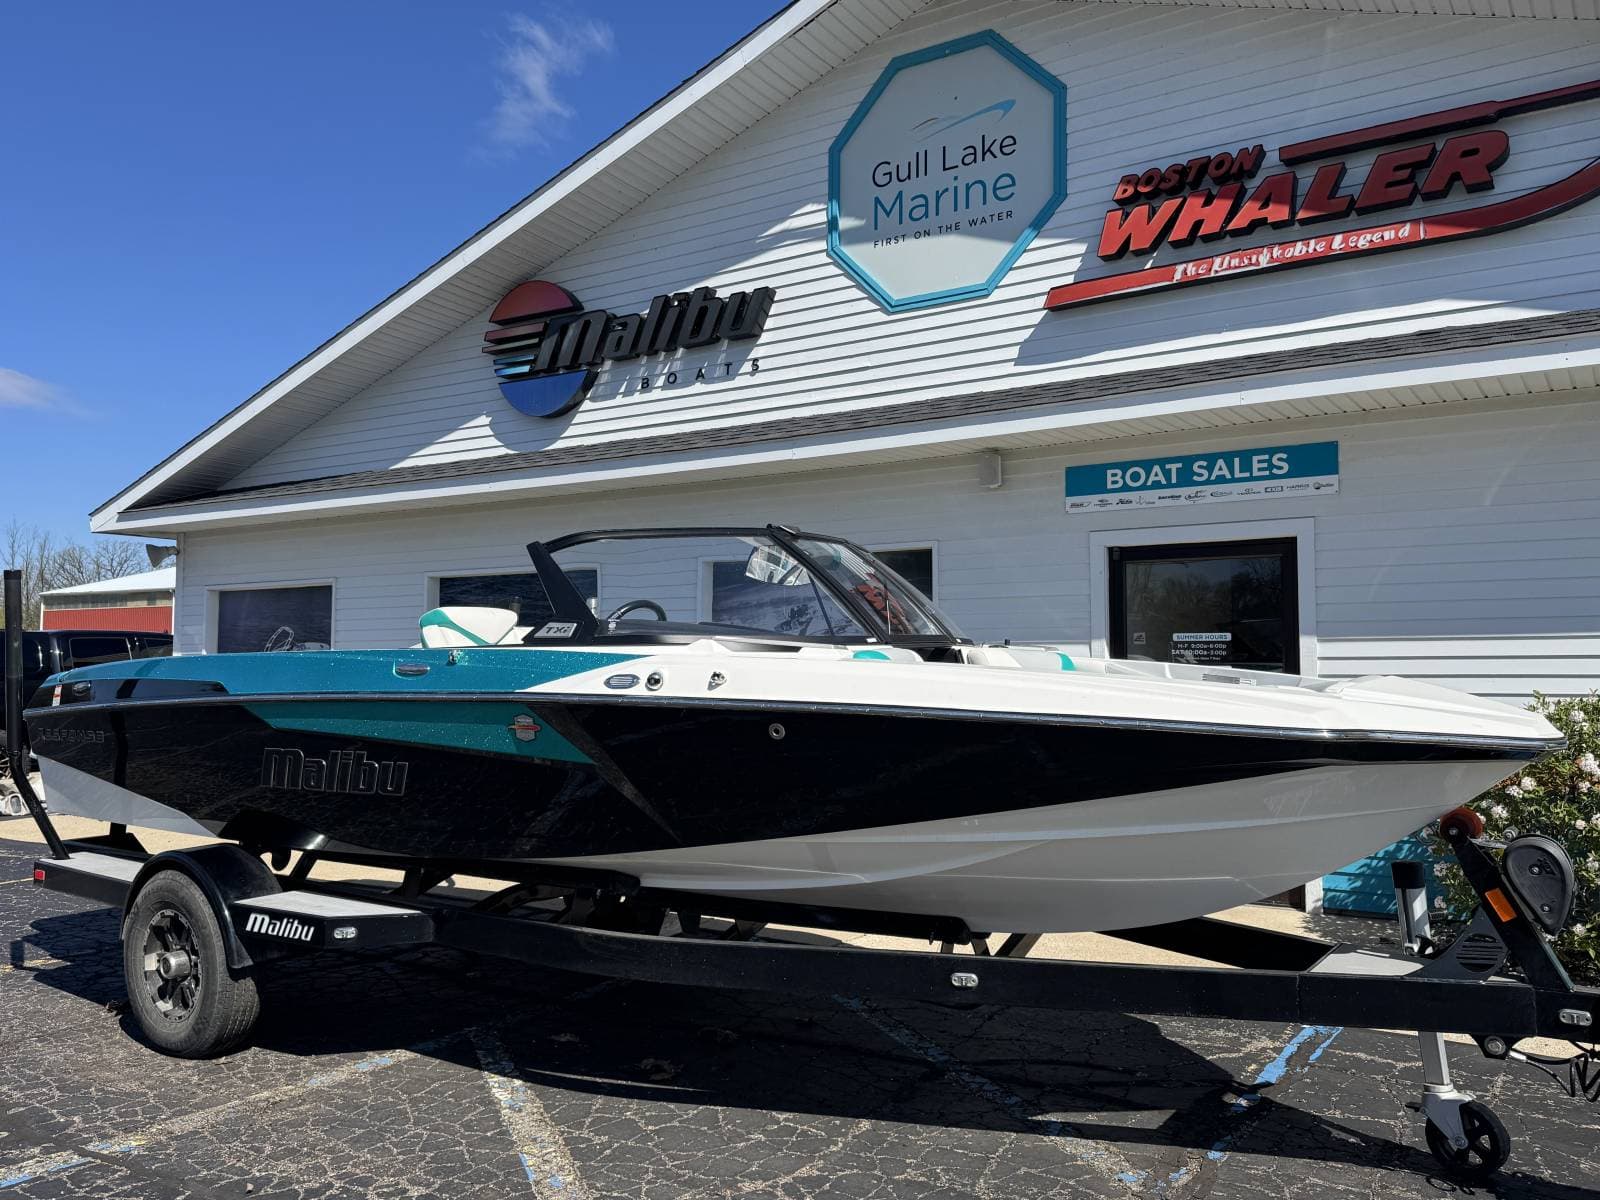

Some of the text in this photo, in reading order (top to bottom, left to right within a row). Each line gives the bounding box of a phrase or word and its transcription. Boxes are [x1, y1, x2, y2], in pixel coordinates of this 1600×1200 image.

[872, 134, 1017, 188] Gull Lake
[1112, 144, 1266, 206] BOSTON
[873, 172, 1017, 231] Marine
[1098, 129, 1510, 263] WHALER
[873, 210, 1014, 248] FIRST ON THE WATER
[1173, 263, 1206, 282] The
[1332, 222, 1411, 251] Legend
[640, 358, 760, 390] BOATS
[1106, 453, 1289, 489] BOAT SALES
